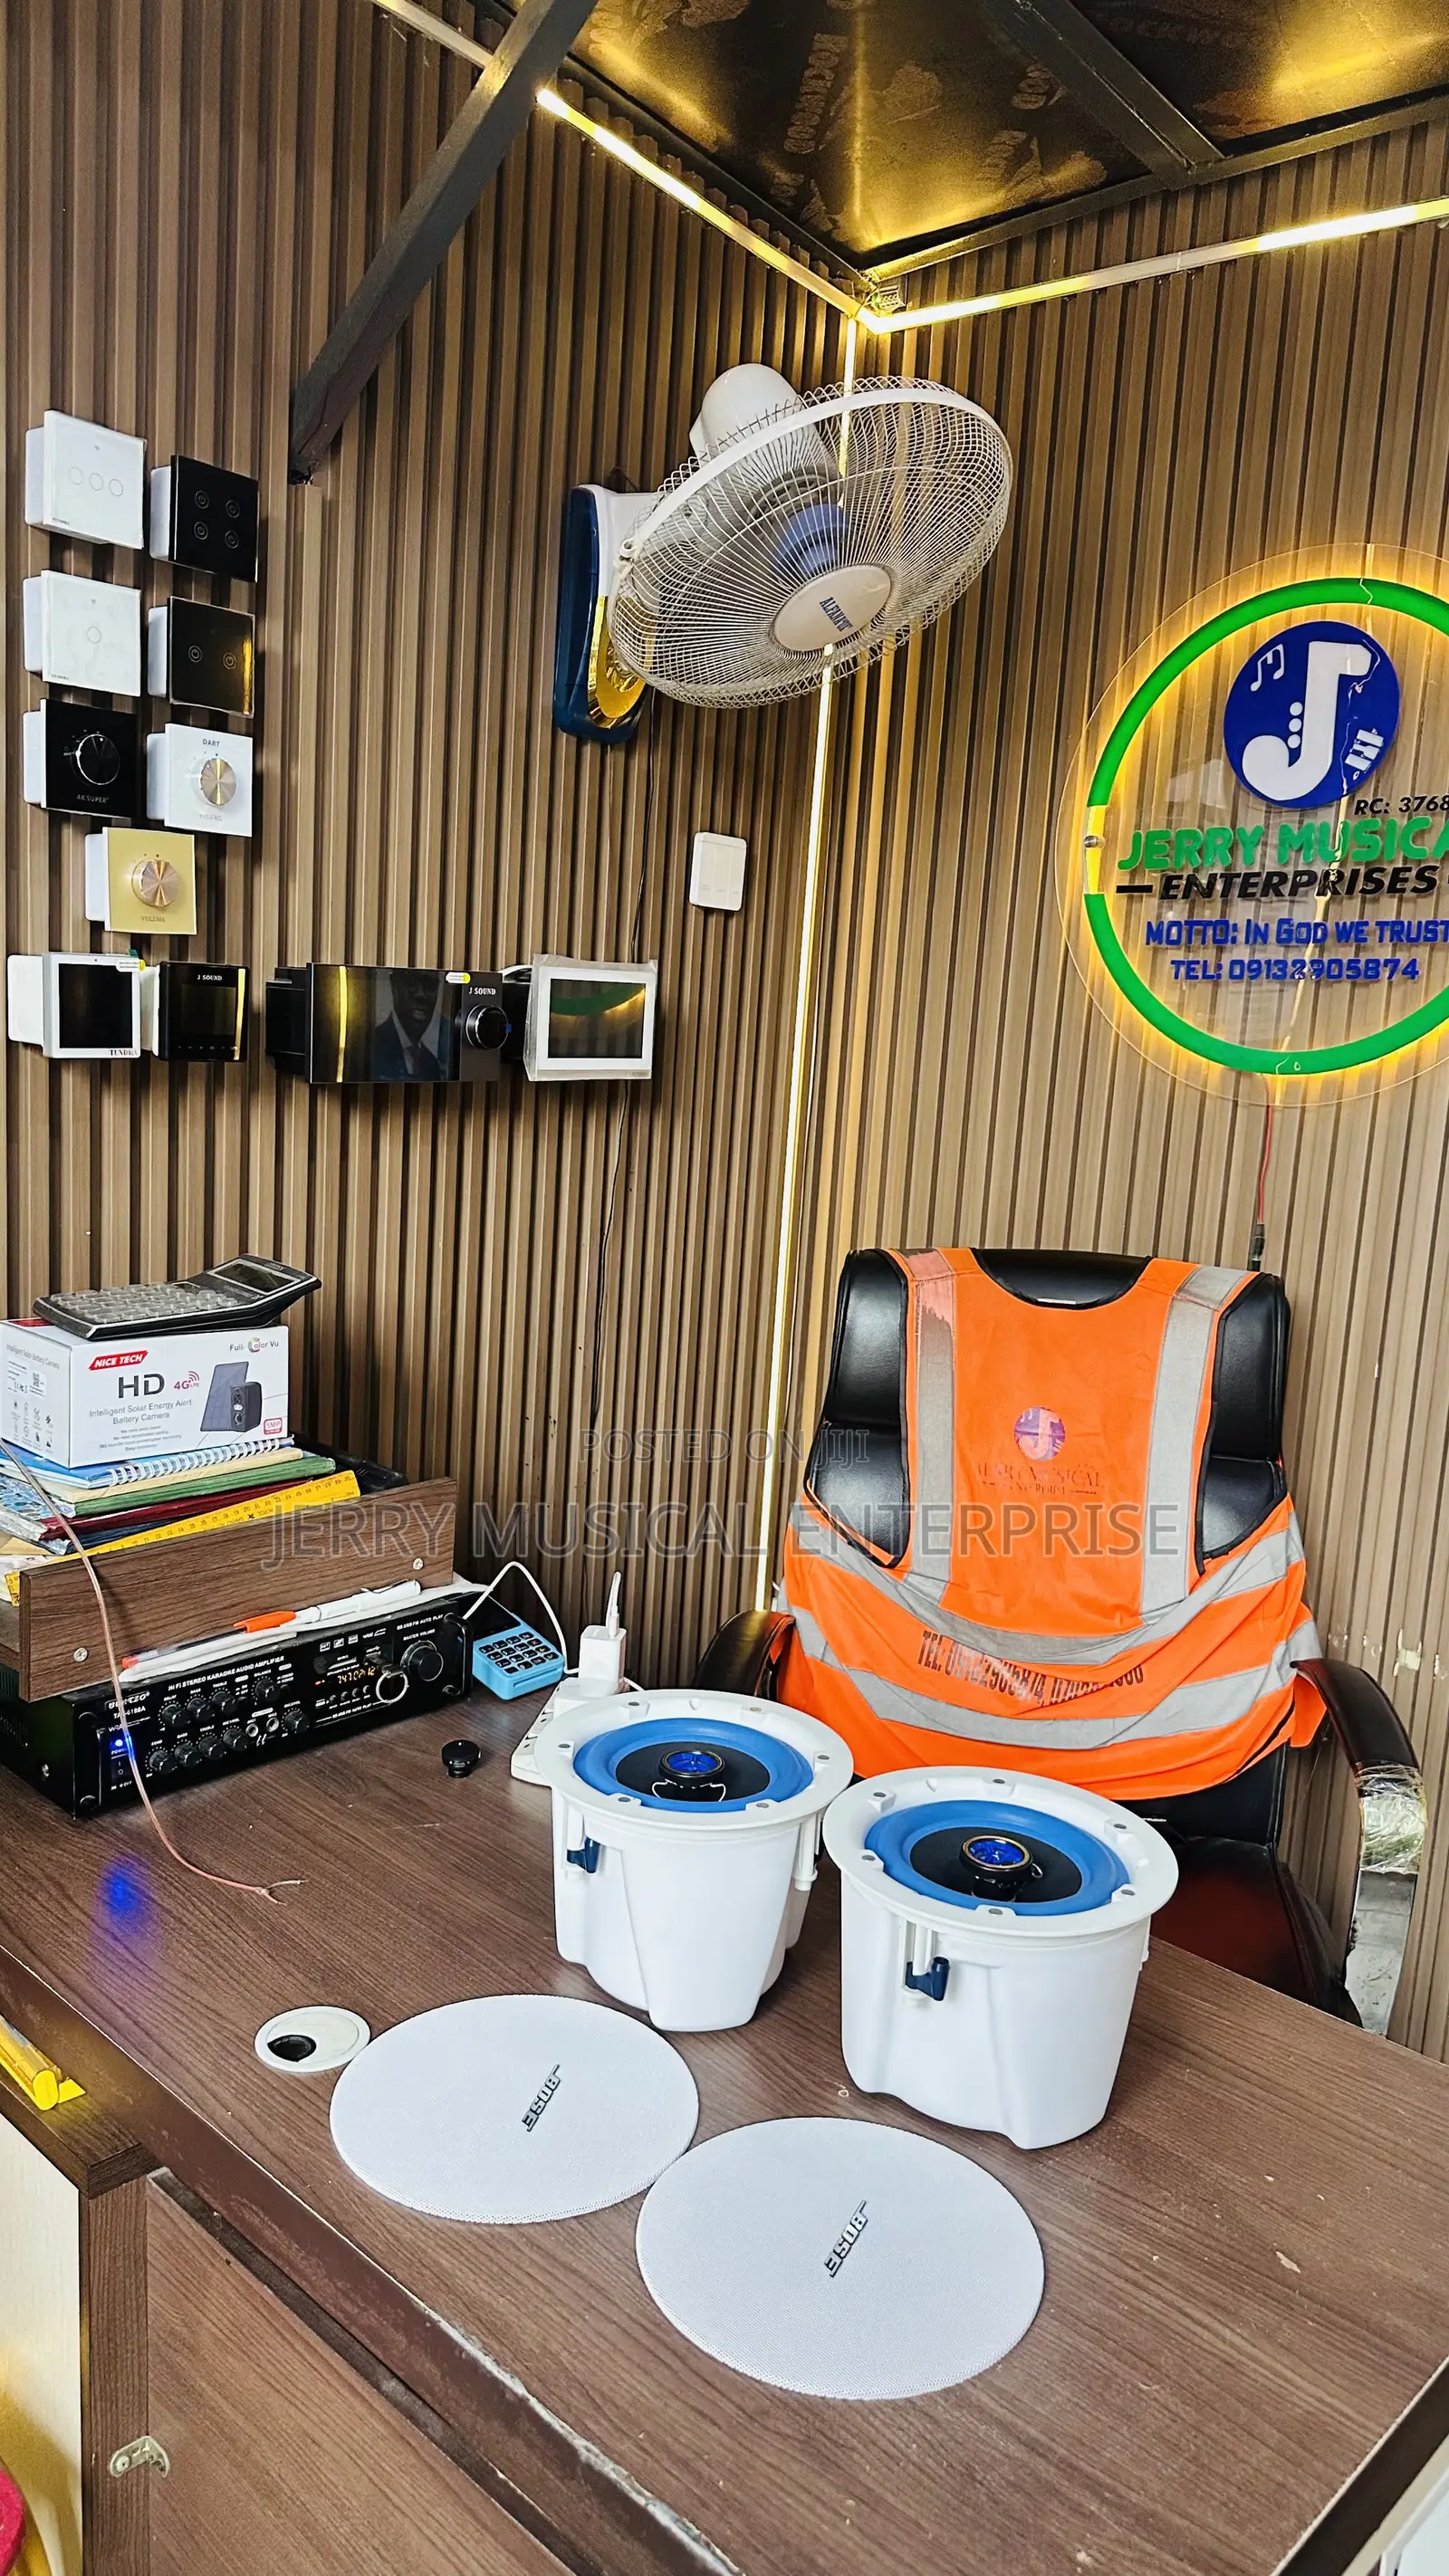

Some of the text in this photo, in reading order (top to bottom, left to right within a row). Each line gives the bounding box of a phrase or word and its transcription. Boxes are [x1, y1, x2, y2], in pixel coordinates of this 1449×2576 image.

[202, 738, 221, 748] DART
[1354, 795, 1449, 815] RC: 3768
[1118, 824, 1265, 870] JERRY
[1159, 865, 1441, 900] ENTERPRISES
[1146, 918, 1239, 946] MOTTO:
[1335, 921, 1369, 943] WE
[1171, 957, 1420, 982] TEL: 09132905874
[468, 987, 496, 995] J SOUND
[270, 1340, 279, 1348] Vu
[94, 1354, 143, 1368] NICE TECH
[119, 1373, 165, 1399] HD
[174, 1379, 190, 1391] 4G
[89, 1399, 192, 1419] Intelligent Solar Energy Alert
[112, 1412, 170, 1426] Battery Camera
[182, 1676, 206, 1688] STEREO
[206, 1668, 235, 1681] KARAOKE
[235, 1663, 254, 1673] AUDIO
[254, 1656, 284, 1669] AMPLIFIER
[522, 2064, 561, 2132] BOSE
[824, 2199, 868, 2278] BOSE
